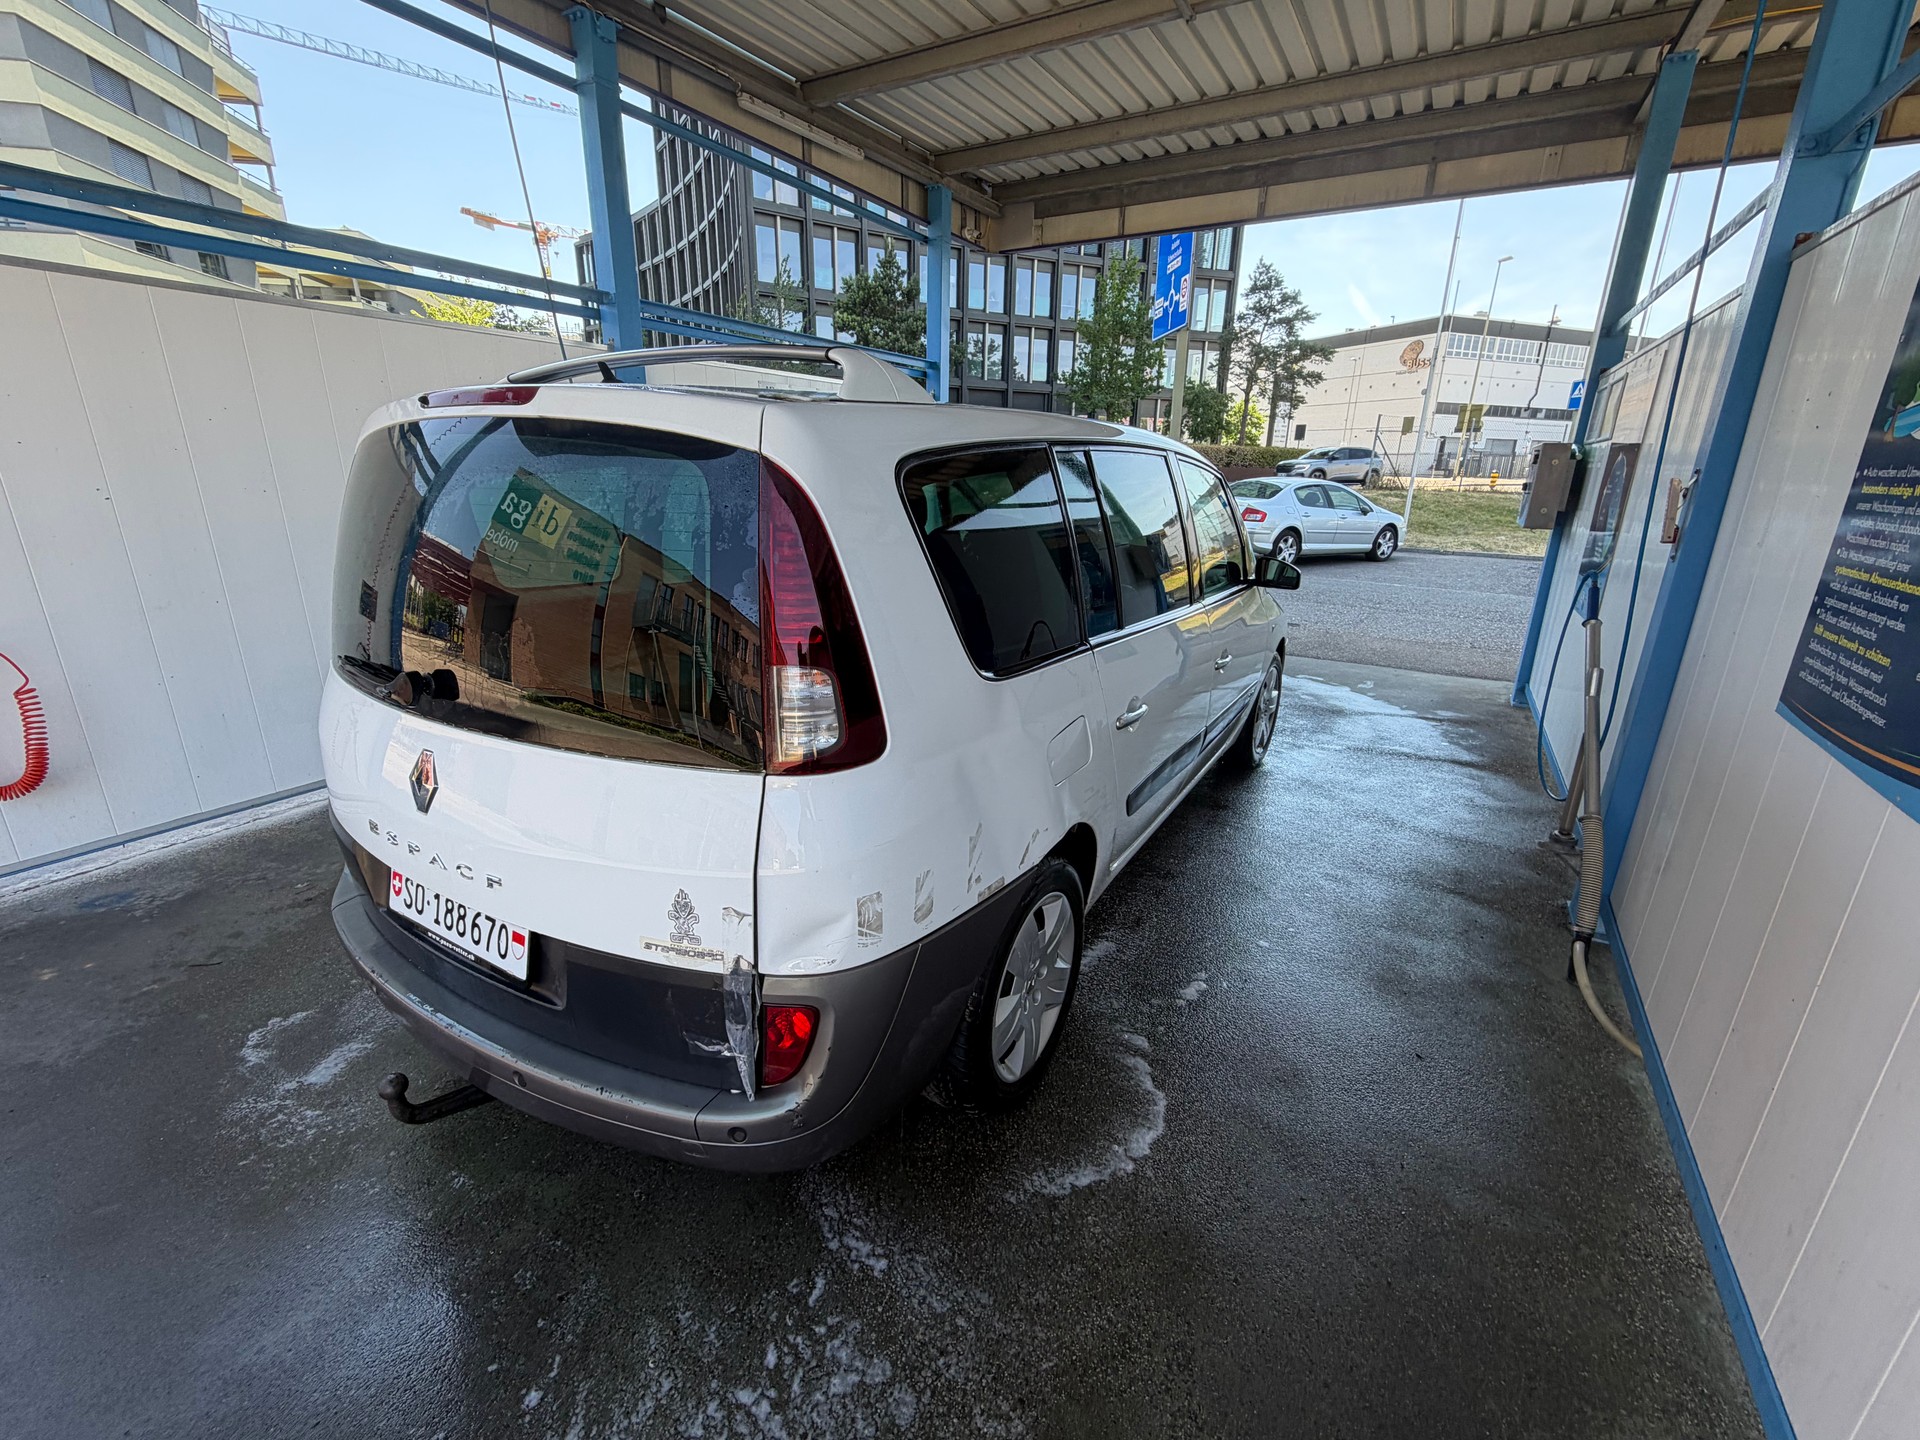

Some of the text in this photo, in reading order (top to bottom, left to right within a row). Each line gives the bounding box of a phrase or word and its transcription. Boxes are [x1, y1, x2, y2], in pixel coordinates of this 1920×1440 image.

[1407, 358, 1431, 369] BUSS
[1861, 482, 1889, 494] besonders
[1888, 483, 1914, 499] niedrige
[1823, 630, 1838, 643] unsere
[1838, 634, 1859, 652] Umwelt
